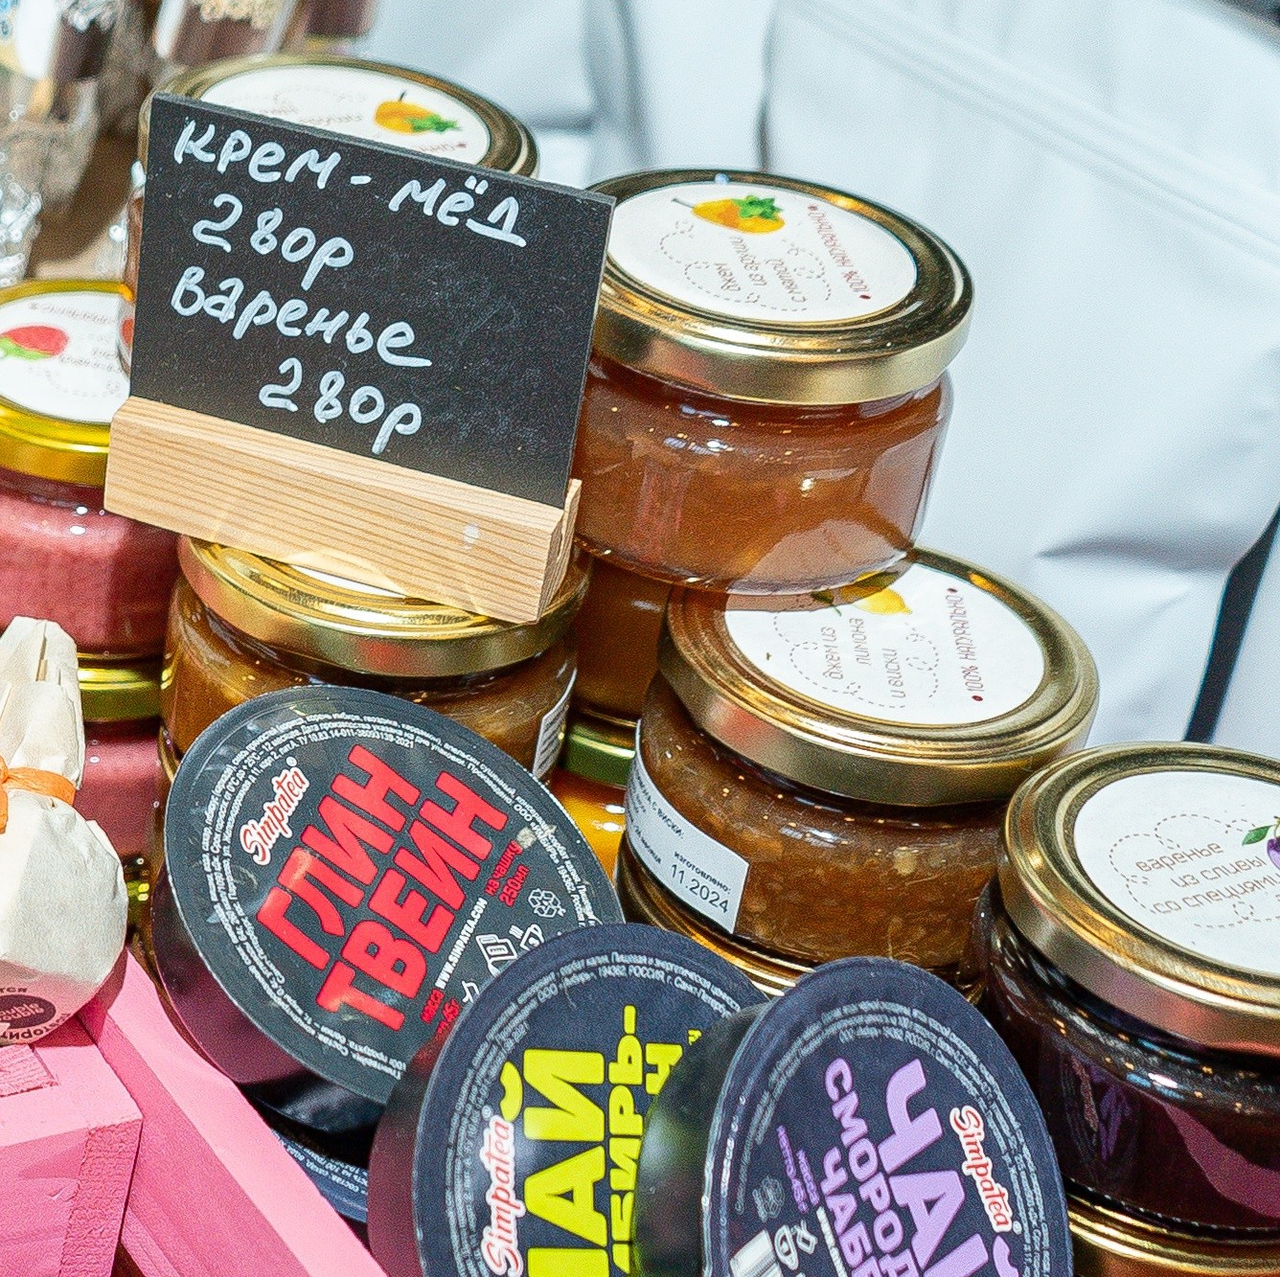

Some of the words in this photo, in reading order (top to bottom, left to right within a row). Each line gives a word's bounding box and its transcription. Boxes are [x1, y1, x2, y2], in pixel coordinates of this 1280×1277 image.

[191, 194, 355, 290] 280р
[169, 265, 432, 369] варенье
[258, 356, 423, 456] 280р
[820, 626, 837, 643] из
[822, 645, 844, 681] джем
[240, 761, 310, 866] Simpatea
[512, 802, 533, 823] ООО
[255, 744, 421, 971] ГЛИН
[1136, 842, 1223, 872] варенье
[1170, 874, 1199, 889] из
[1200, 856, 1267, 881] сливы
[671, 864, 729, 913] 11.2024
[1153, 900, 1182, 914] со
[949, 1104, 1015, 1236] Simpatea
